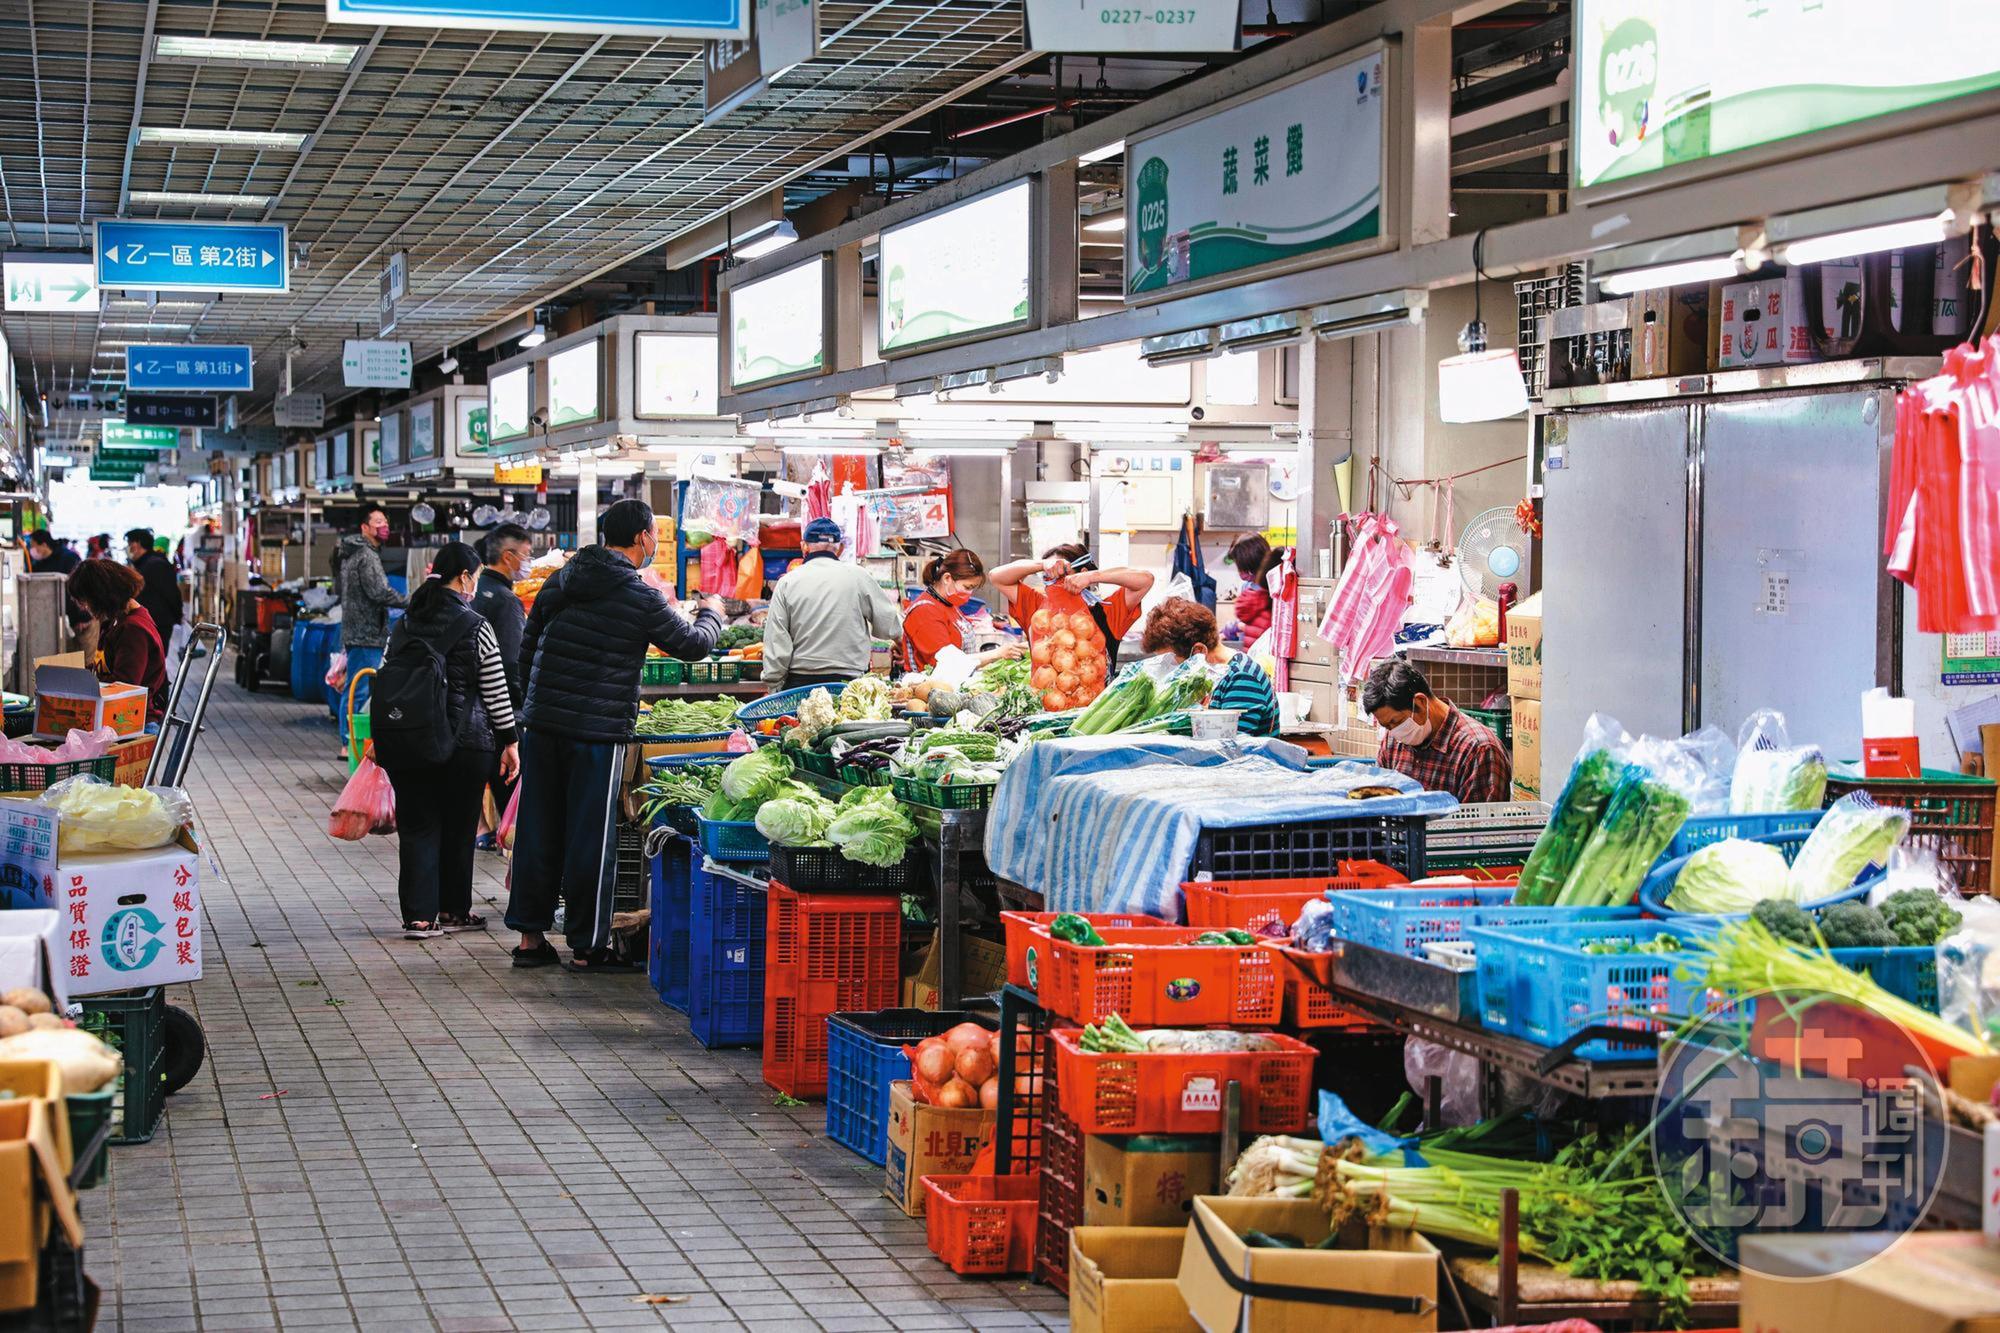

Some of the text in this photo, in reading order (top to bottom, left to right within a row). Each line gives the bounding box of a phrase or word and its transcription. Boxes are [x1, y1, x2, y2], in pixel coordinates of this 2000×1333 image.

[1101, 9, 1196, 24] 0227~0237
[1223, 123, 1303, 195] 蔬菜攤
[1142, 200, 1166, 233] 0225
[126, 244, 257, 268] 乙一區 第2街
[1765, 293, 1781, 350] 花瓜
[147, 361, 231, 375] 乙一區 第1街
[926, 504, 944, 521] 4
[1510, 646, 1532, 666] 花胡瓜
[68, 876, 92, 977] 品質保證
[172, 864, 196, 965] 分級包裝
[1156, 1171, 1186, 1204] 特
